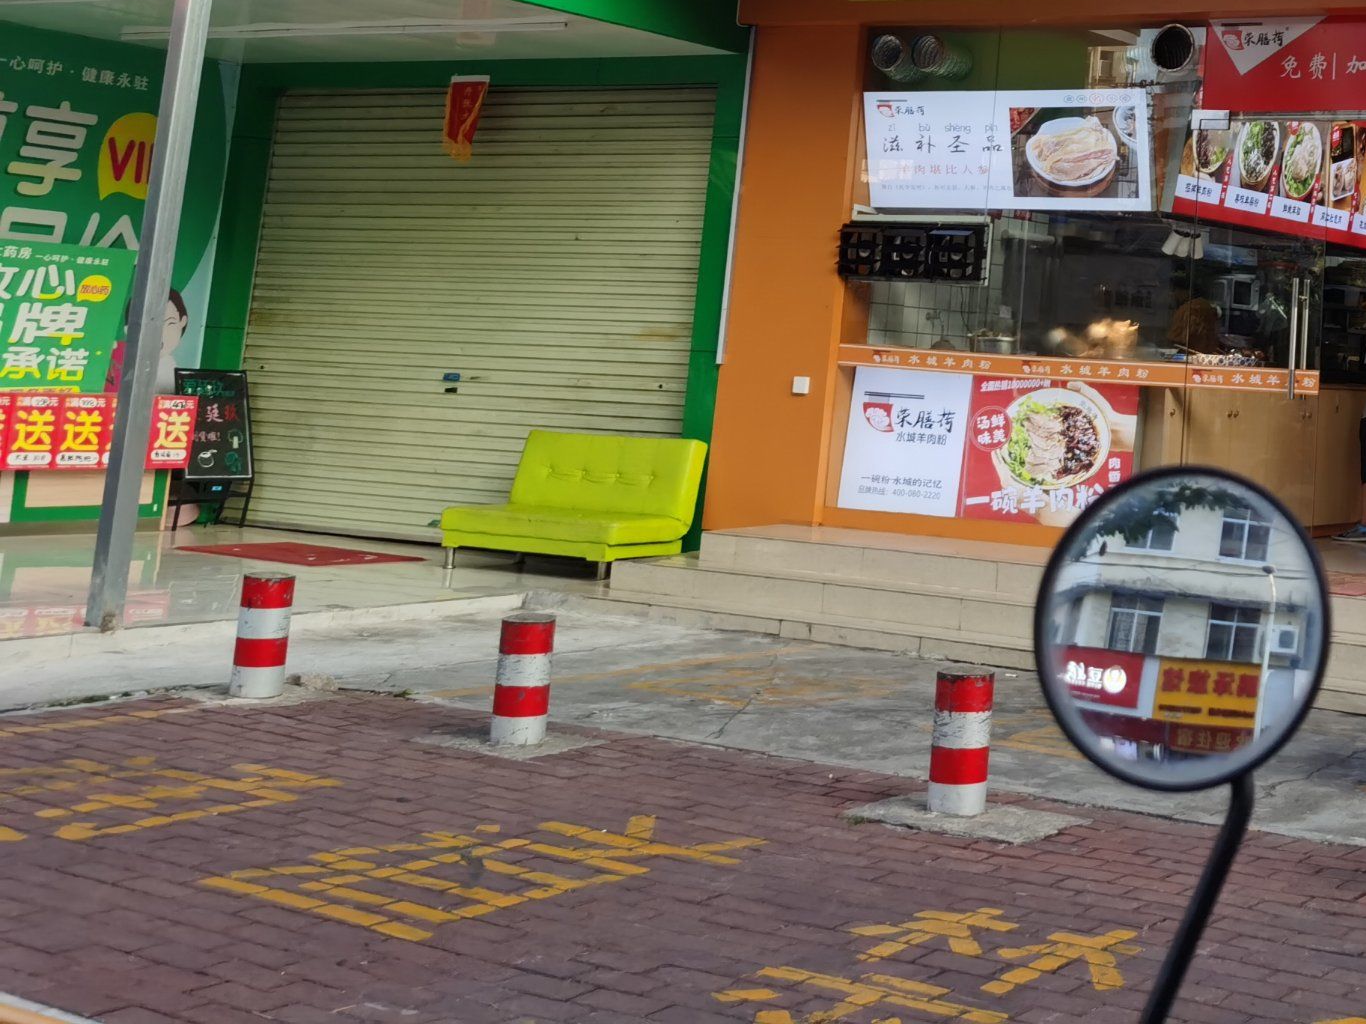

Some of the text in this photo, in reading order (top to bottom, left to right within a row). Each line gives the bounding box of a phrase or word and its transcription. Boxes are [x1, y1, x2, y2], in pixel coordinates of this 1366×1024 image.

[0, 91, 98, 196] 享
[882, 134, 1003, 154] 滋补圣品
[0, 346, 89, 381] 承诺
[908, 355, 992, 370] 水城羊肉粉
[1060, 364, 1149, 379] 水城羊肉粉
[11, 409, 55, 451] 送
[60, 410, 103, 451] 送
[153, 411, 191, 448] 送
[977, 414, 1006, 430] 汤鲜
[896, 433, 948, 446] 水城羊肉粉
[977, 429, 1006, 445] 味美
[966, 483, 1104, 514] 一碗羊肉粉
